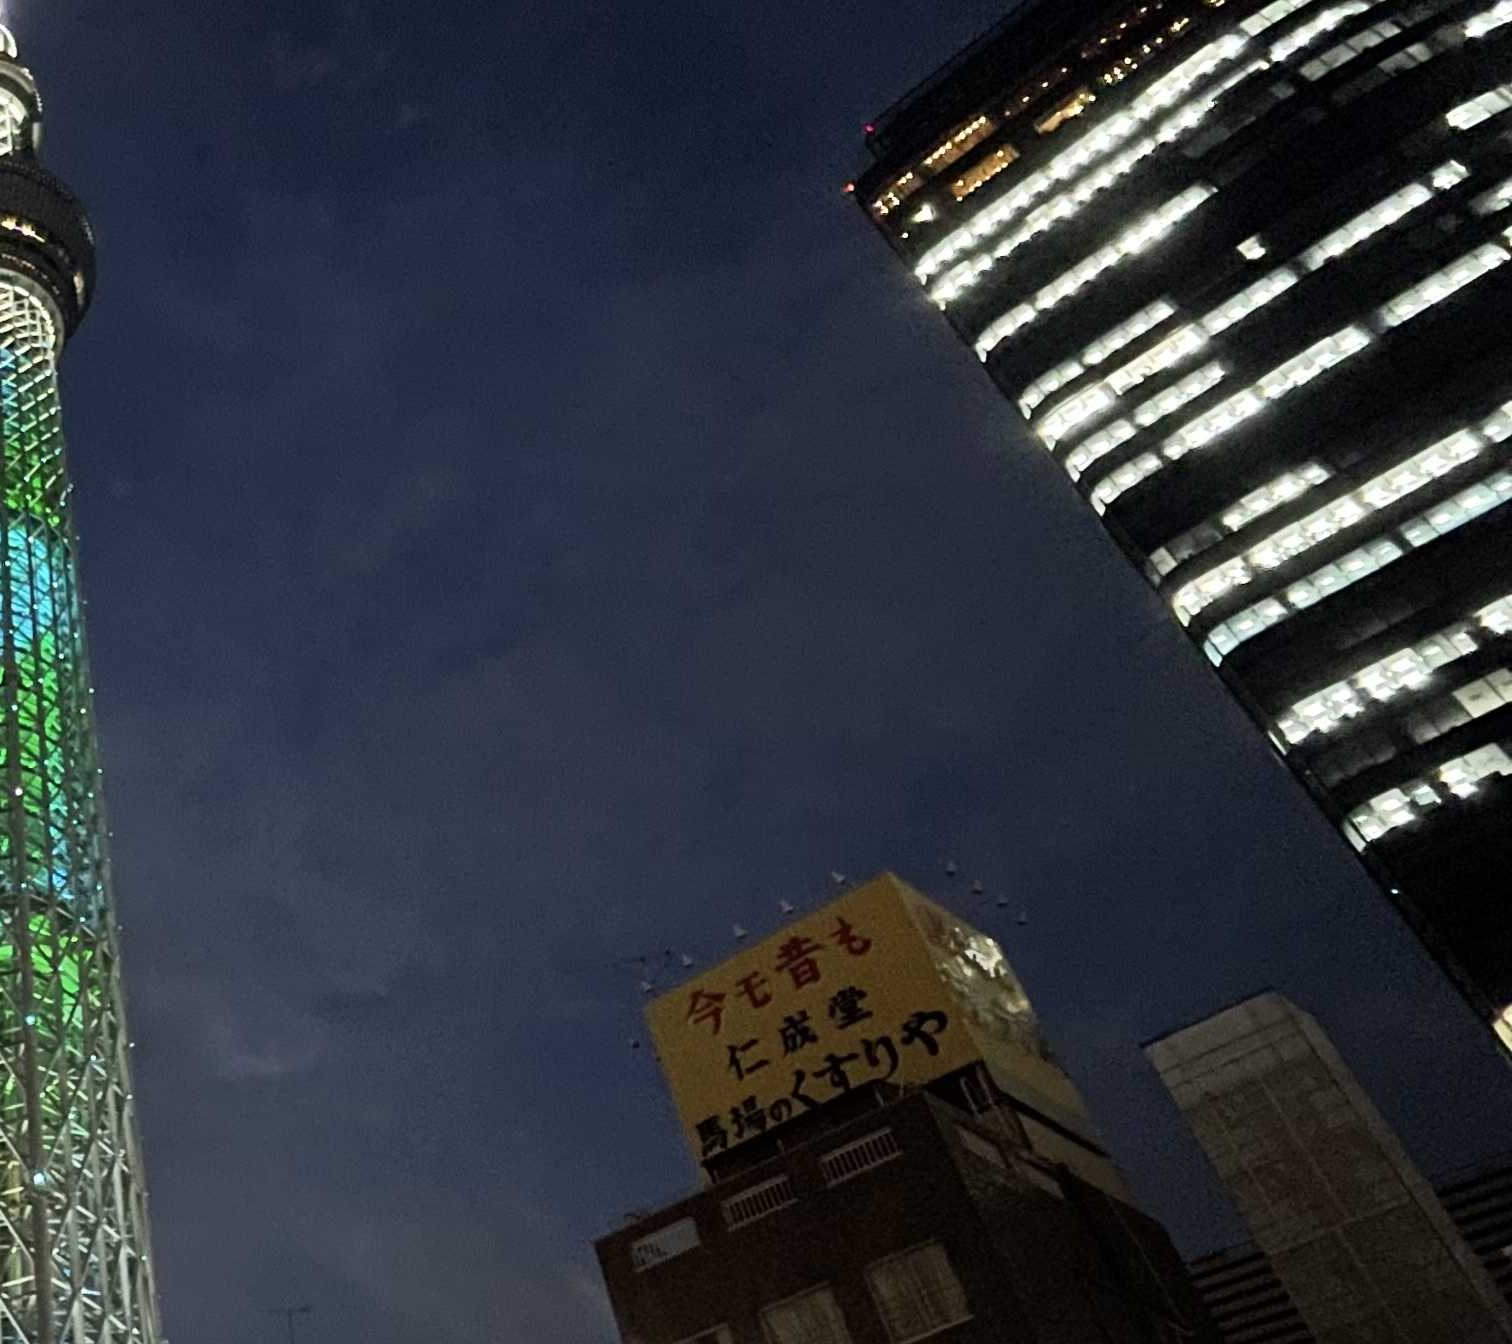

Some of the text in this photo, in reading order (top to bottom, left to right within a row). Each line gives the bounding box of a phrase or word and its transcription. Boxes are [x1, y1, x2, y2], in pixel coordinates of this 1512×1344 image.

[685, 916, 873, 1035] 今モ昔も
[725, 985, 874, 1081] 仁成堂
[694, 1009, 949, 1156] 馬場のくすりや
